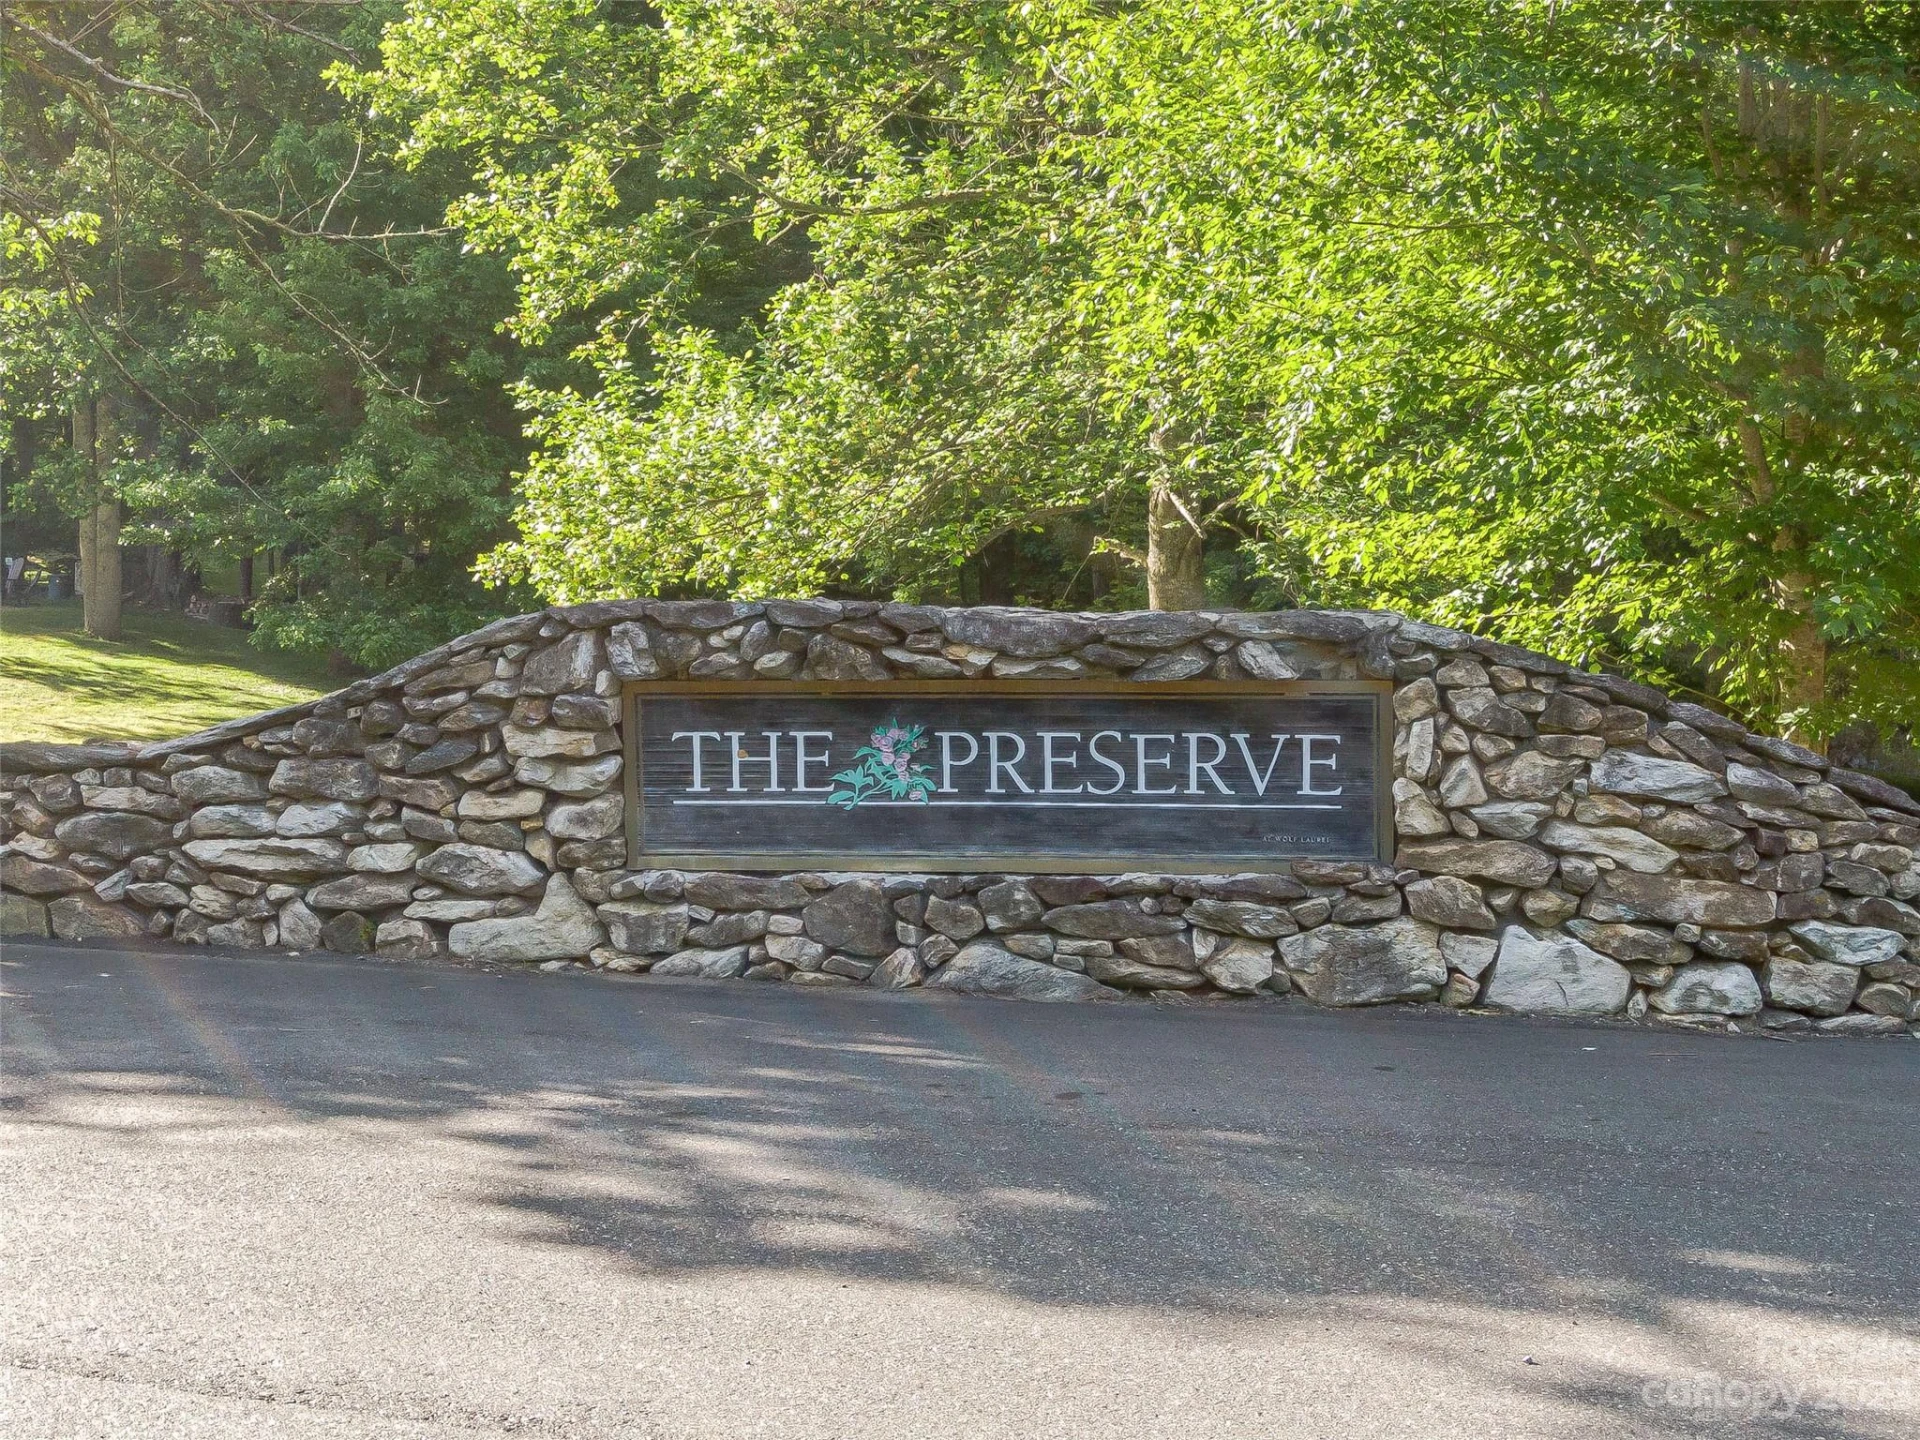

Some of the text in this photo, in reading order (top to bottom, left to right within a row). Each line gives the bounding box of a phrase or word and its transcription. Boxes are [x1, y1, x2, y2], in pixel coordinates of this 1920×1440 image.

[671, 730, 1344, 797] THE PRESERVE
[1275, 835, 1297, 843] WOLF
[1300, 836, 1331, 844] LAUREL
